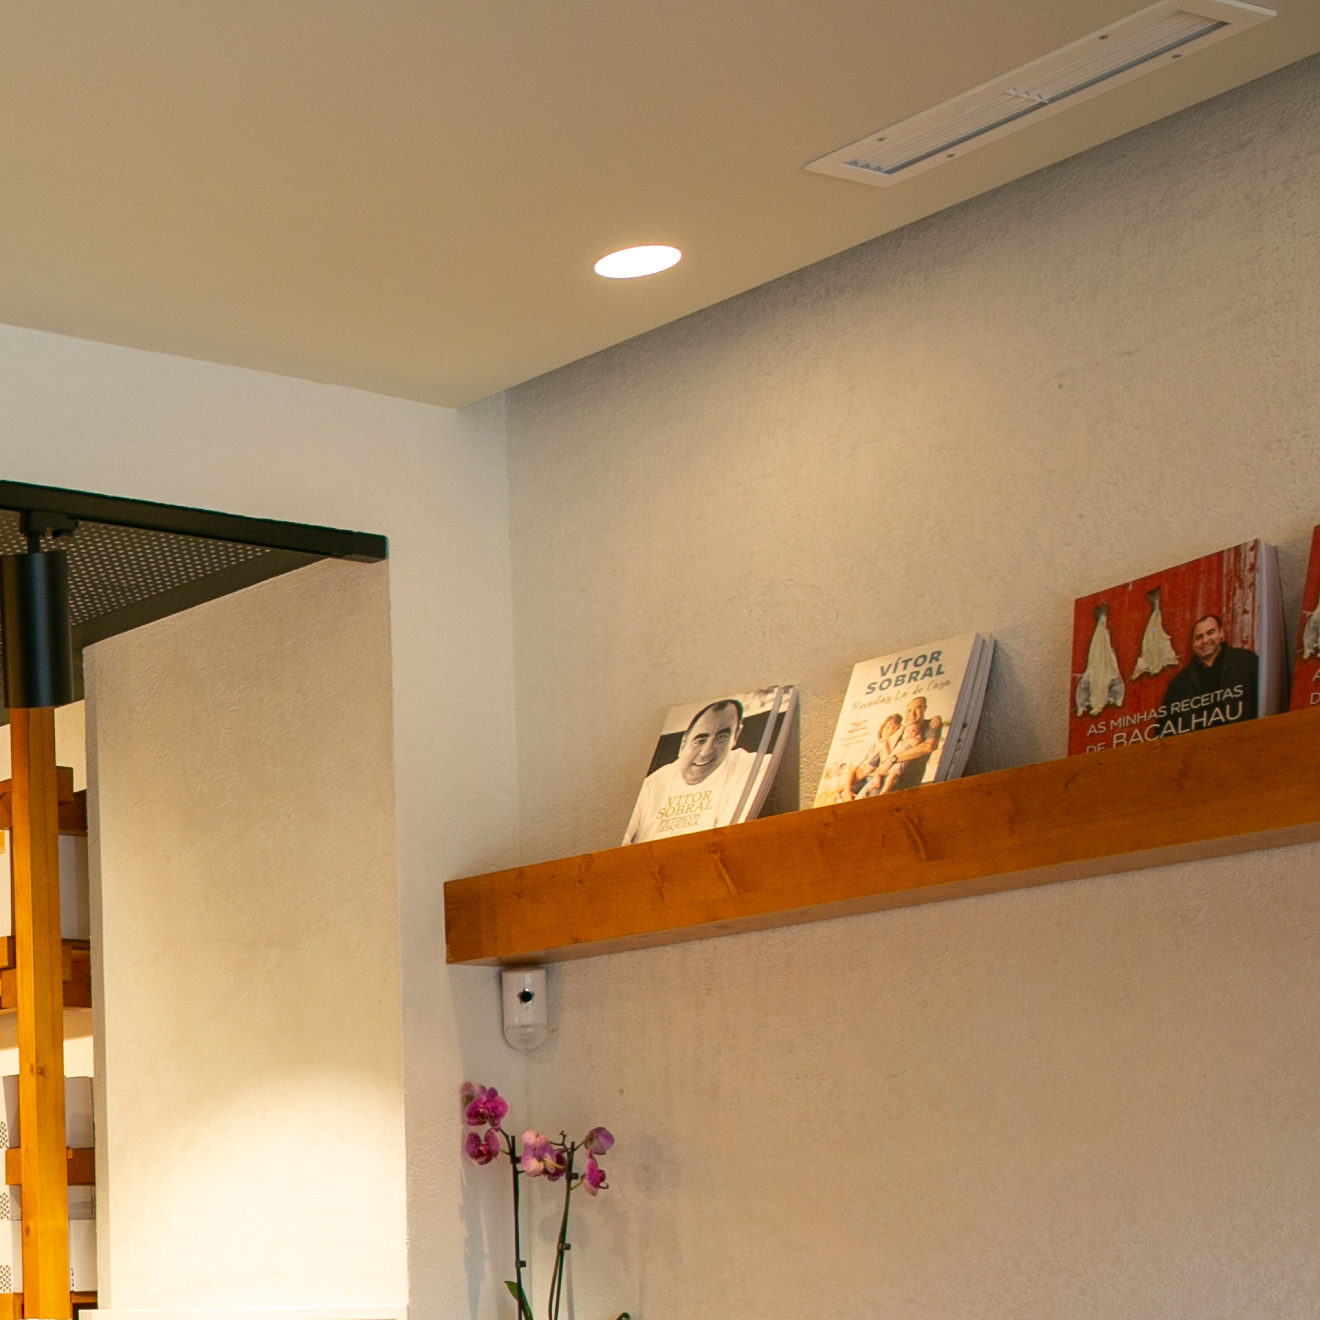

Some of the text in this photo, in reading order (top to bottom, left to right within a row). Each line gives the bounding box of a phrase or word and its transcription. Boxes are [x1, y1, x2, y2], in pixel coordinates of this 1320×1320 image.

[880, 650, 942, 677] VÍTOR
[865, 664, 945, 695] SOBRAL
[1086, 685, 1244, 736] AS MINHAS RECEITAS
[1112, 701, 1244, 748] BACALHAU
[656, 800, 713, 819] SOBRAL
[668, 790, 712, 806] VÍTOR
